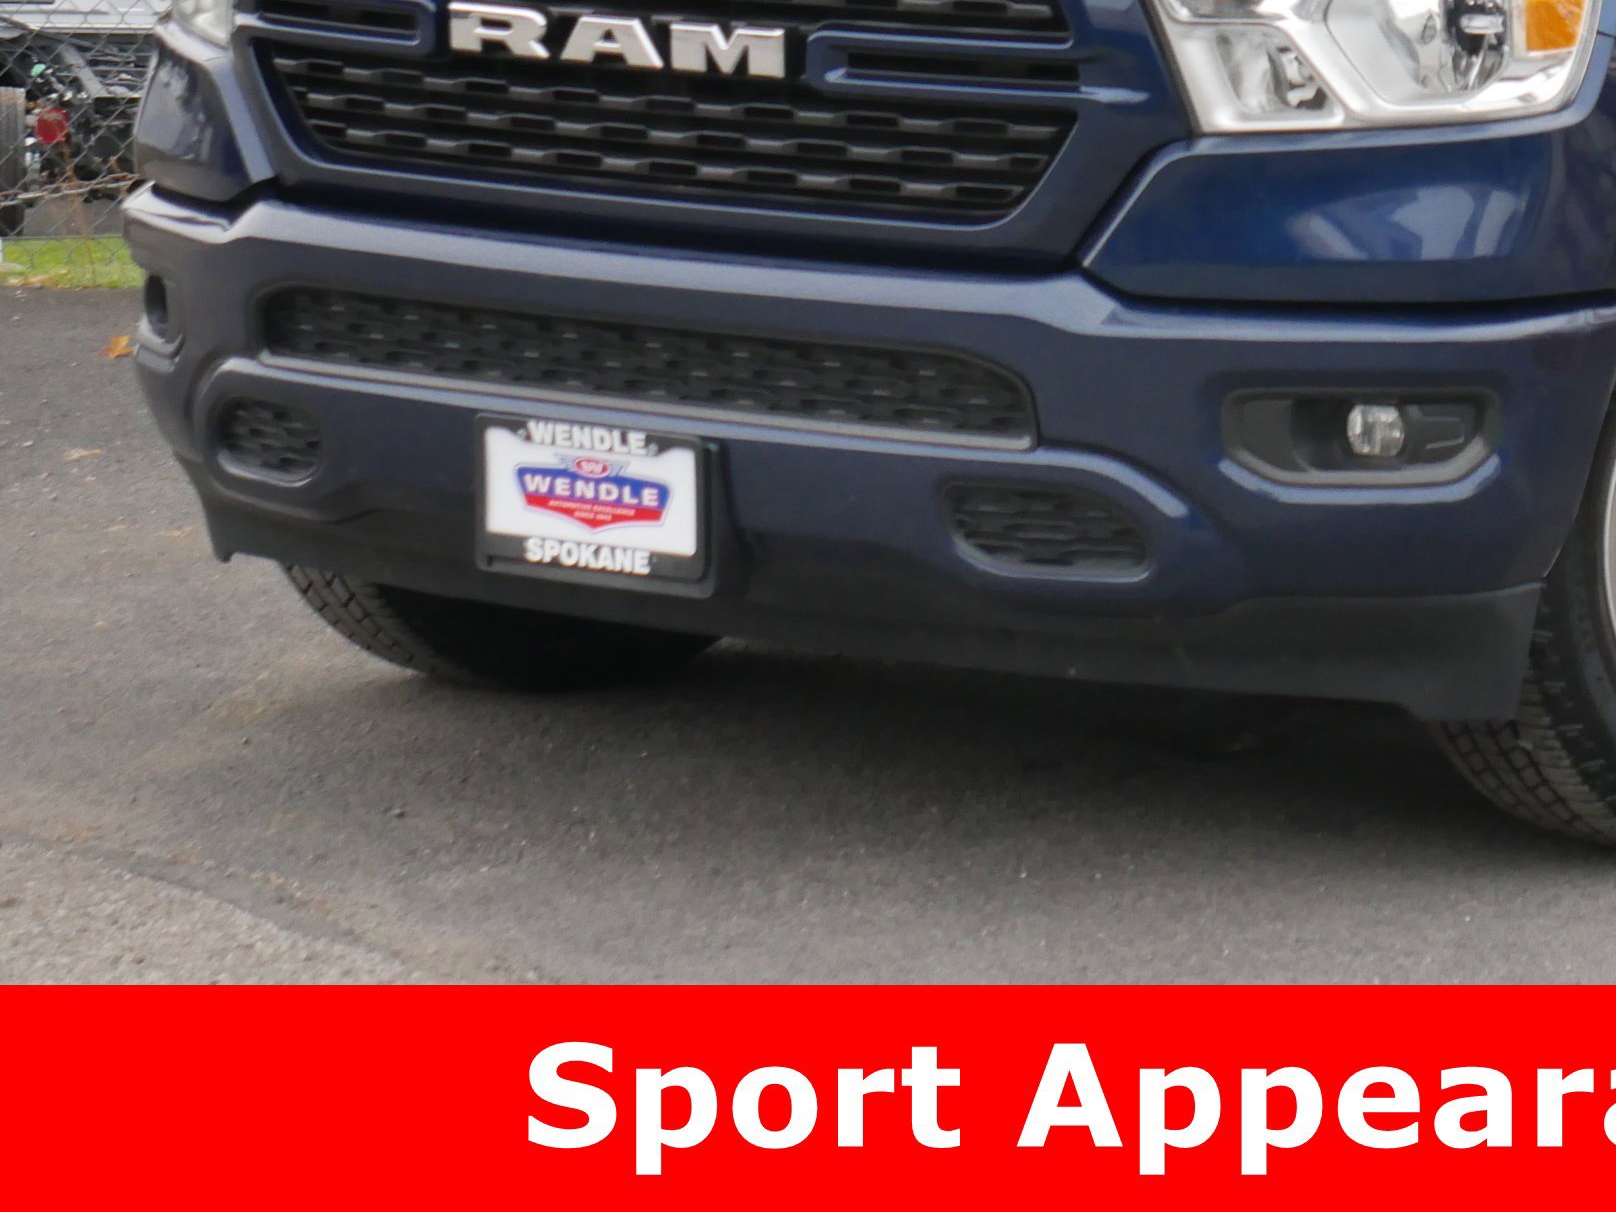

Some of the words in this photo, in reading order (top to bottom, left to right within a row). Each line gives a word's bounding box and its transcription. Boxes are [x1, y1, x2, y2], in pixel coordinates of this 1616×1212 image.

[448, 1, 786, 79] RAM
[527, 421, 648, 455] WENDLE
[523, 474, 660, 506] WENDLE
[524, 538, 652, 576] SPOKANE
